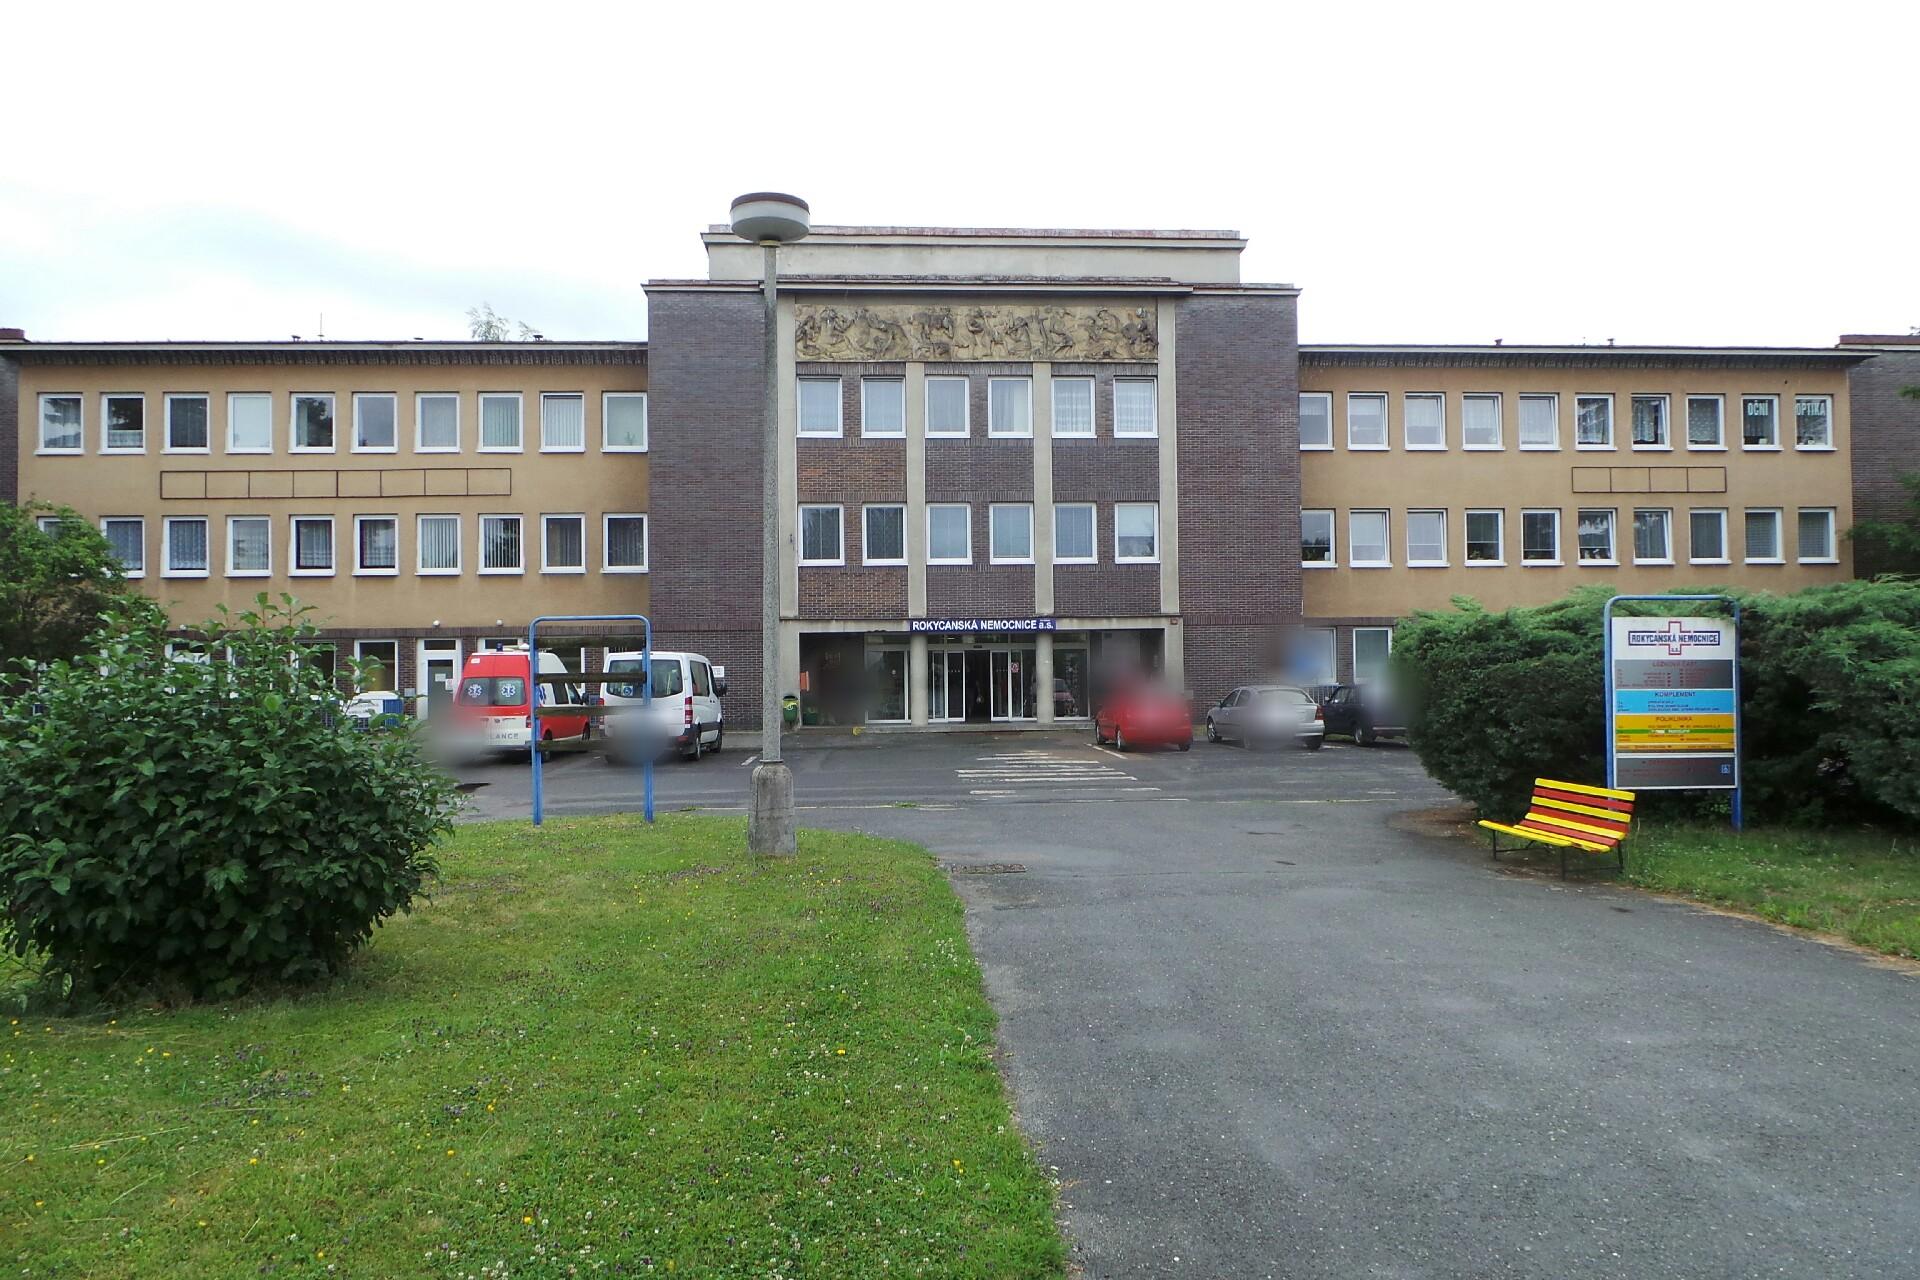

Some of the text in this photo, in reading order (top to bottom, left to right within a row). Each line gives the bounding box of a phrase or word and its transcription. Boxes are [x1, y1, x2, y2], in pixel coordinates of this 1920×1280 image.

[1747, 400, 1826, 416] OČNÍ OPTIKA
[912, 619, 1054, 631] ROKYCANSKÁ NEMOCNICE a.s.
[1631, 633, 1718, 643] ROKYCANSKÁ NEMOCNICE
